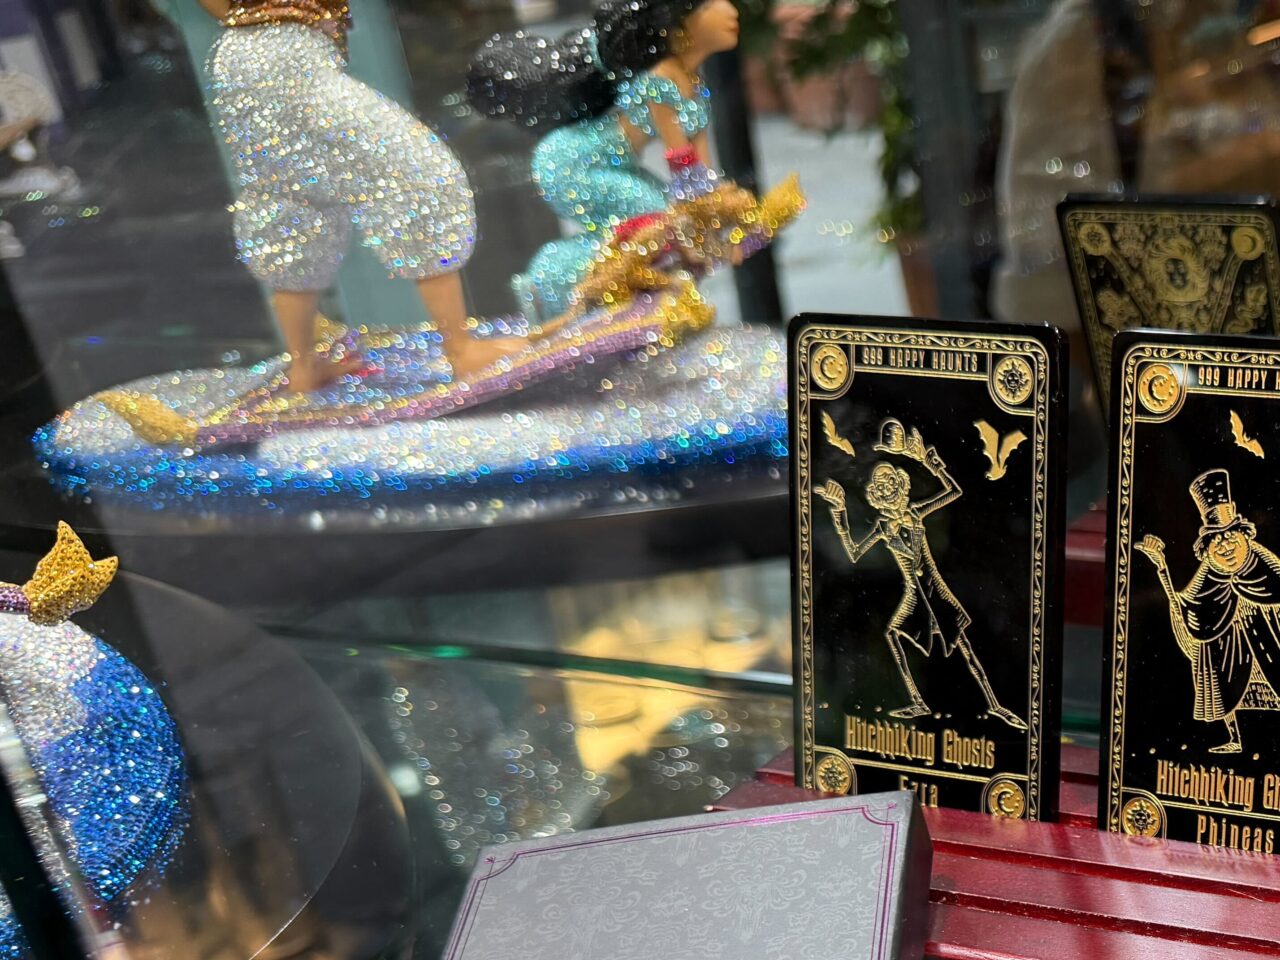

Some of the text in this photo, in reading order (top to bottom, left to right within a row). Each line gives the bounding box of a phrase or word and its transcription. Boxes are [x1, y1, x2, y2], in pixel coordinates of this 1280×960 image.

[861, 345, 978, 373] 999 HAPPY HAUNTS
[1198, 366, 1220, 387] 999
[1227, 367, 1268, 390] HAPPY
[845, 713, 996, 770] Hitchhiking Ghosts
[1156, 758, 1255, 812] Hitchhiking
[1196, 813, 1275, 854] Phineas
